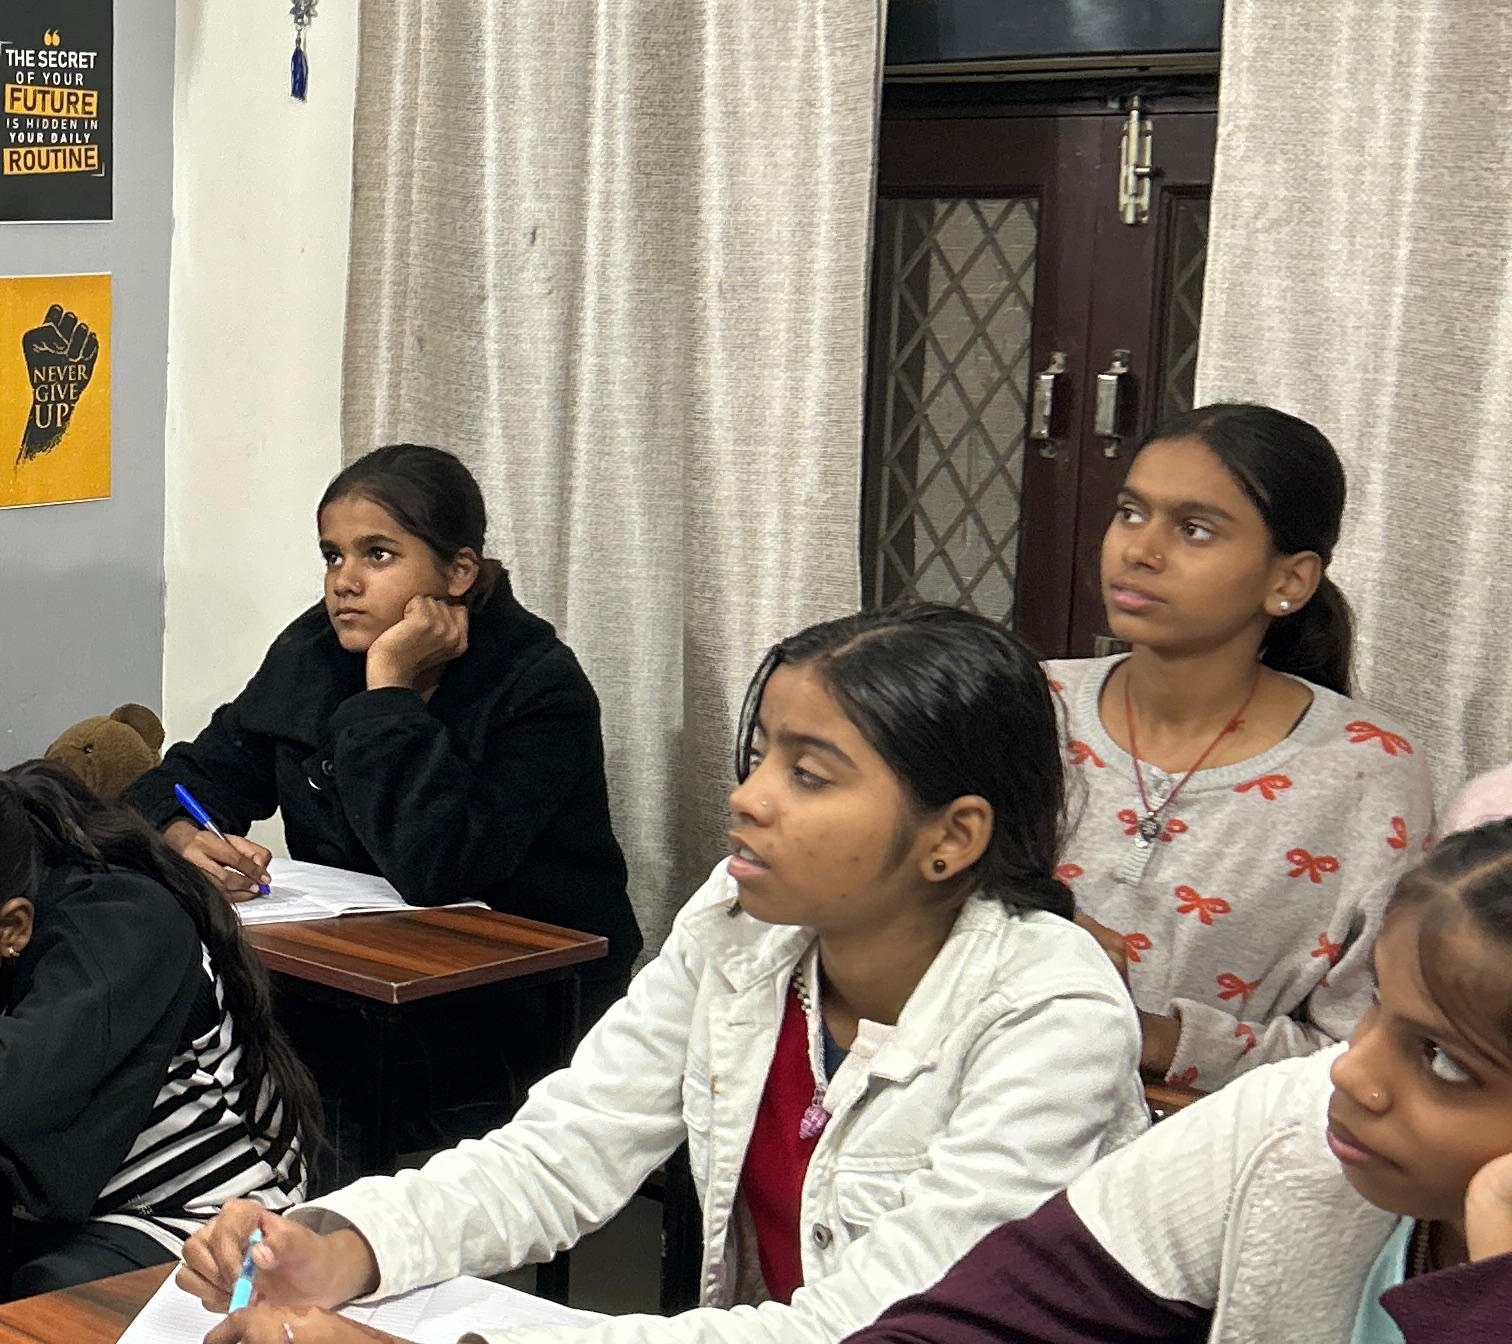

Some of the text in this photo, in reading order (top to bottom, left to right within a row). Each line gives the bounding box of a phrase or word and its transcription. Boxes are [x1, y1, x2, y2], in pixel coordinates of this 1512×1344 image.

[5, 49, 97, 69] THE SECRET
[16, 71, 84, 86] OF YOUR
[9, 87, 95, 116] FUTURE
[6, 118, 98, 130] IS HIDDEN IN
[9, 131, 91, 144] YOUR DAILY
[9, 147, 96, 172] ROUTINE
[33, 364, 88, 383] NEVER
[35, 382, 79, 402] GIVE
[35, 402, 68, 428] UP
